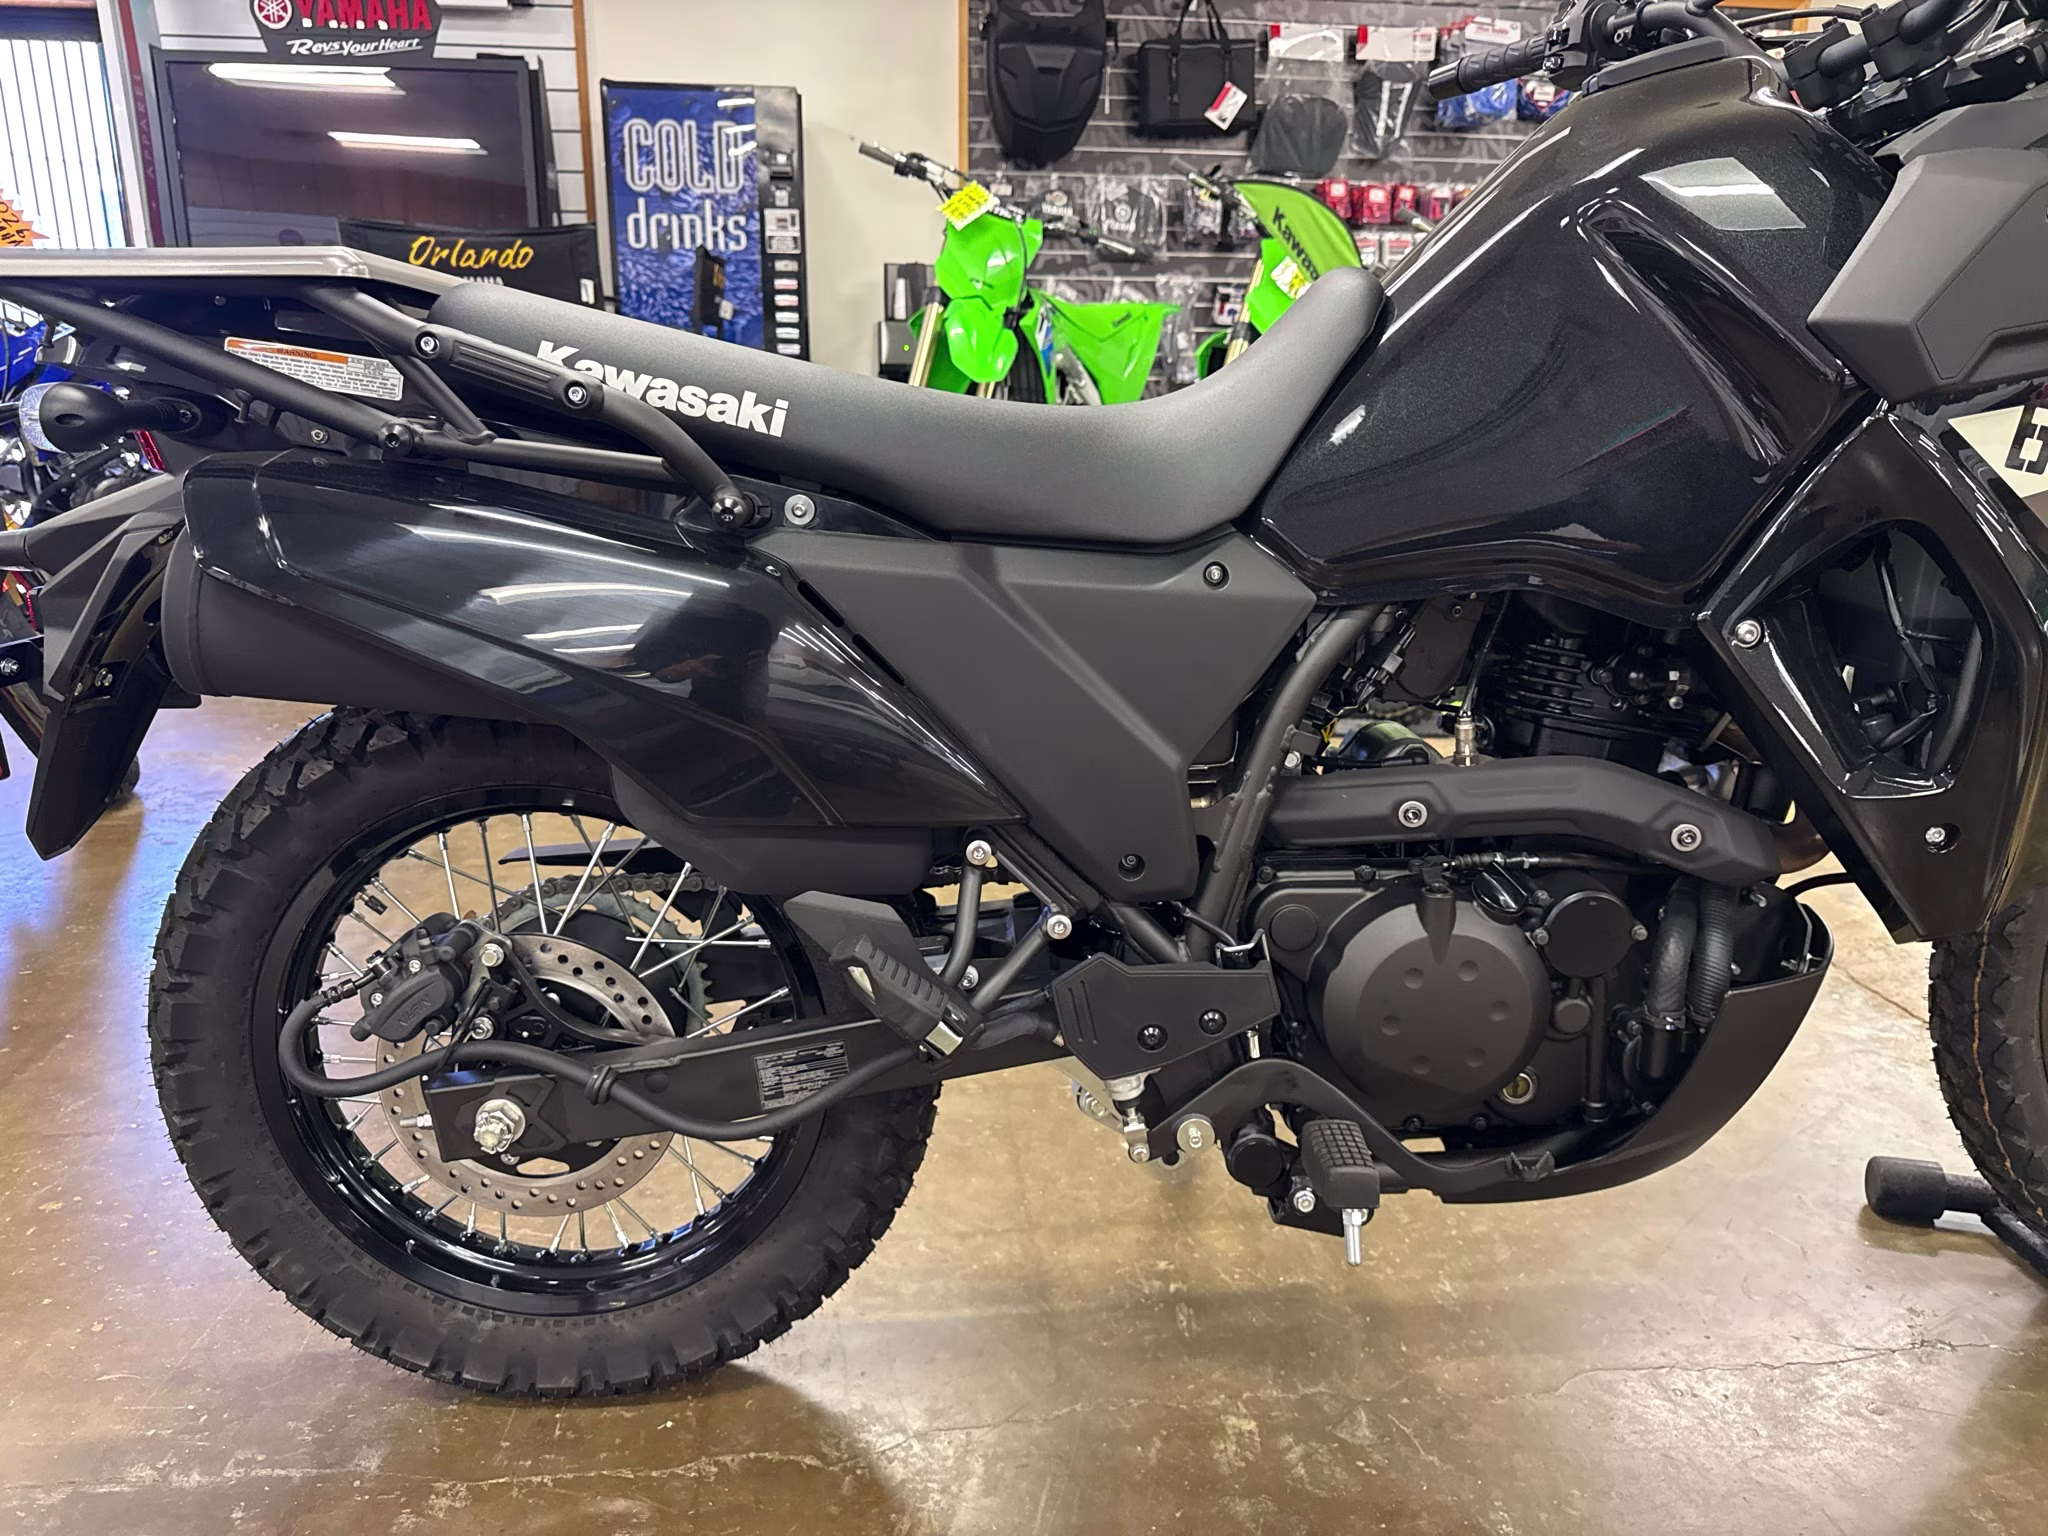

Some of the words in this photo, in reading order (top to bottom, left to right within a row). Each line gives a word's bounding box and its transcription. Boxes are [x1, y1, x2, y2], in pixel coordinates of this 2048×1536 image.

[296, 0, 433, 31] YAMAHA
[285, 38, 341, 56] Revs
[339, 40, 380, 56] Your
[378, 37, 424, 51] Heart
[623, 117, 746, 195] COLD
[626, 196, 748, 252] drinks
[408, 235, 535, 270] Orlando
[276, 347, 317, 360] WARNING
[536, 339, 790, 438] Kawasaki
